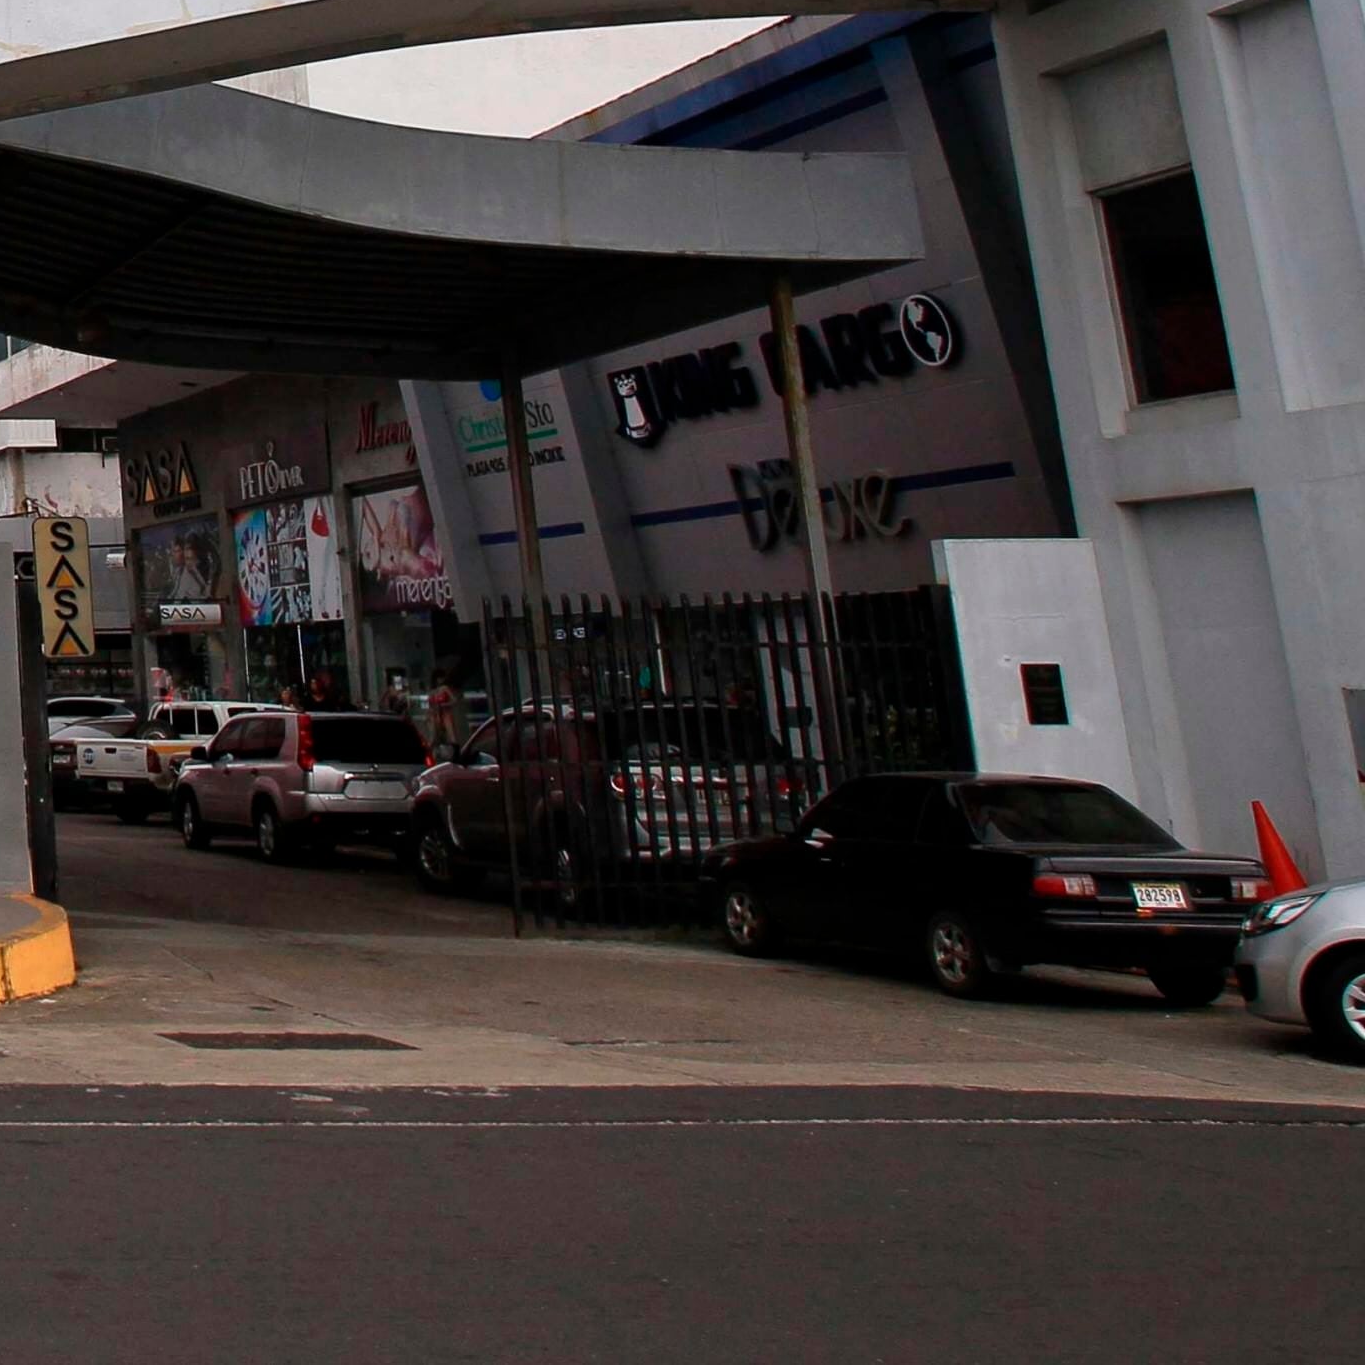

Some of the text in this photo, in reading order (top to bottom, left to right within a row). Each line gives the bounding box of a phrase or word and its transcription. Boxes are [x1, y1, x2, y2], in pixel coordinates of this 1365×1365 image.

[125, 438, 200, 507] SASA
[46, 521, 90, 656] SASA
[161, 607, 206, 620] SASA
